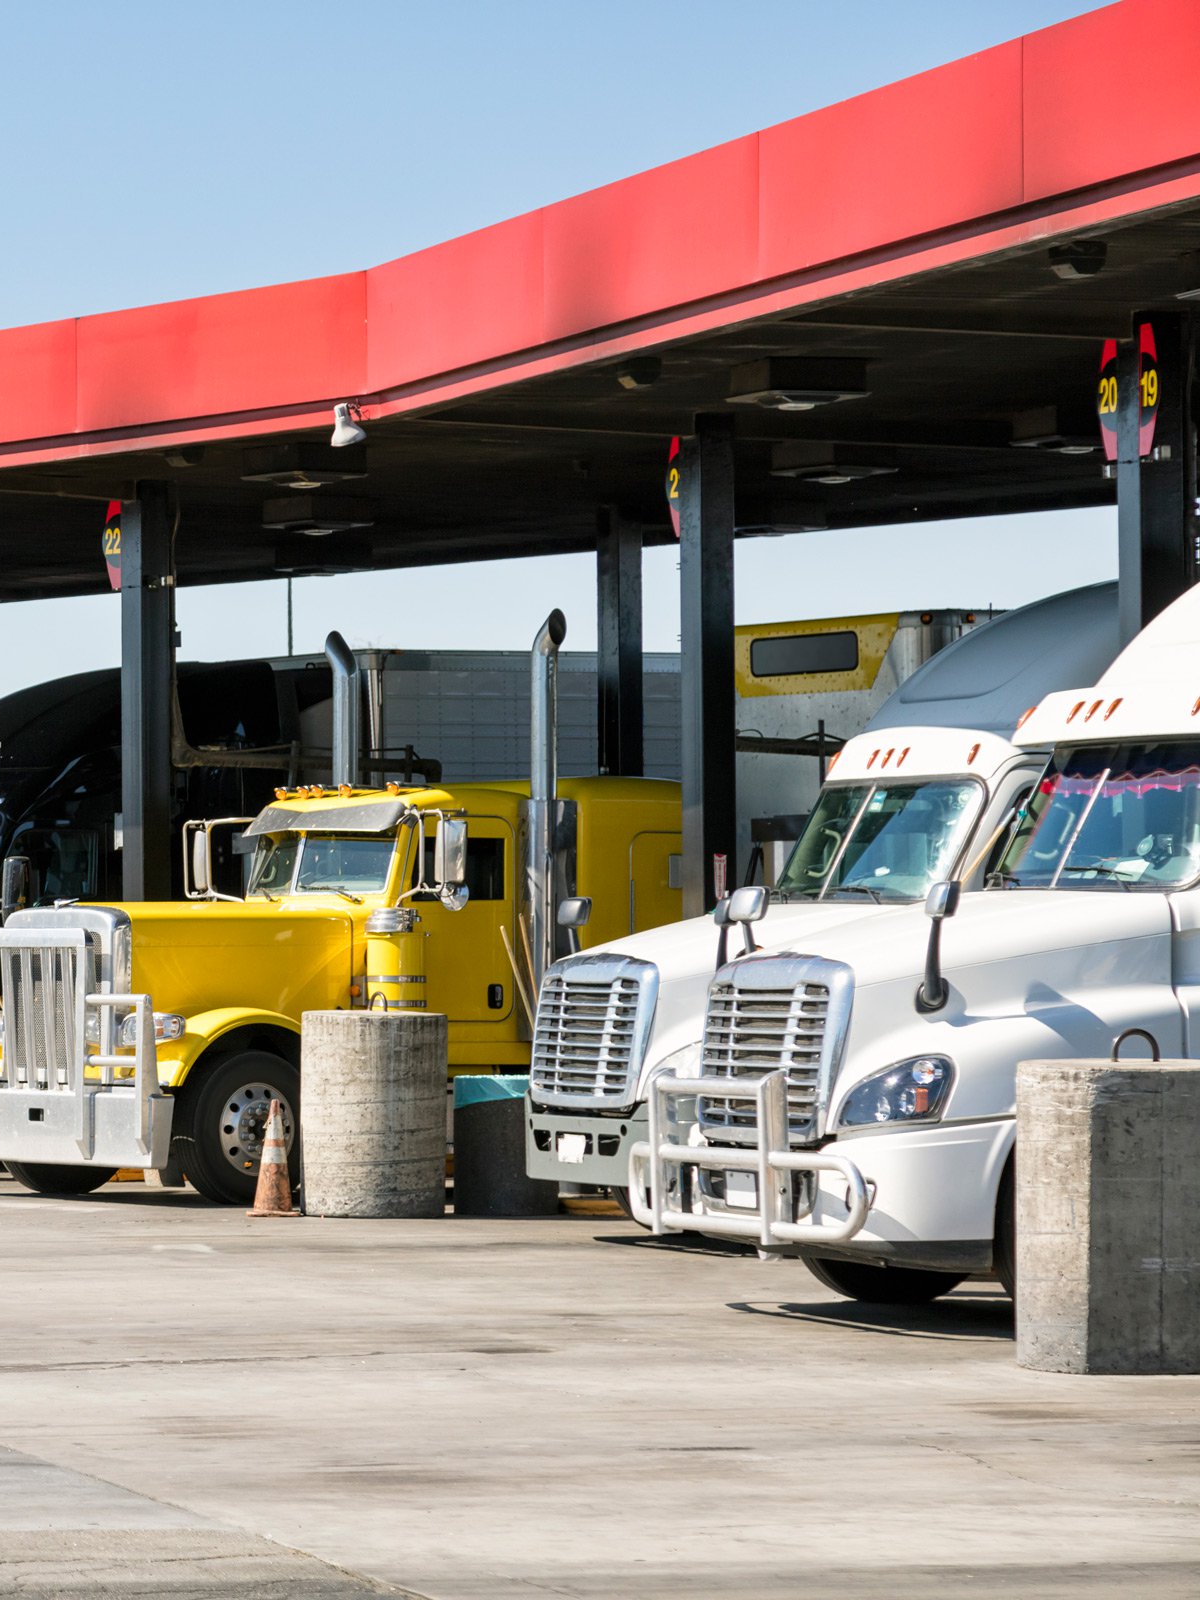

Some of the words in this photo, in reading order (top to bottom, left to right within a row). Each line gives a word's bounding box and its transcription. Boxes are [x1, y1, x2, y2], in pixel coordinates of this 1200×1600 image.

[1099, 376, 1117, 415] 20
[1140, 369, 1158, 407] 19
[670, 468, 680, 499] 2
[105, 527, 121, 555] 22
